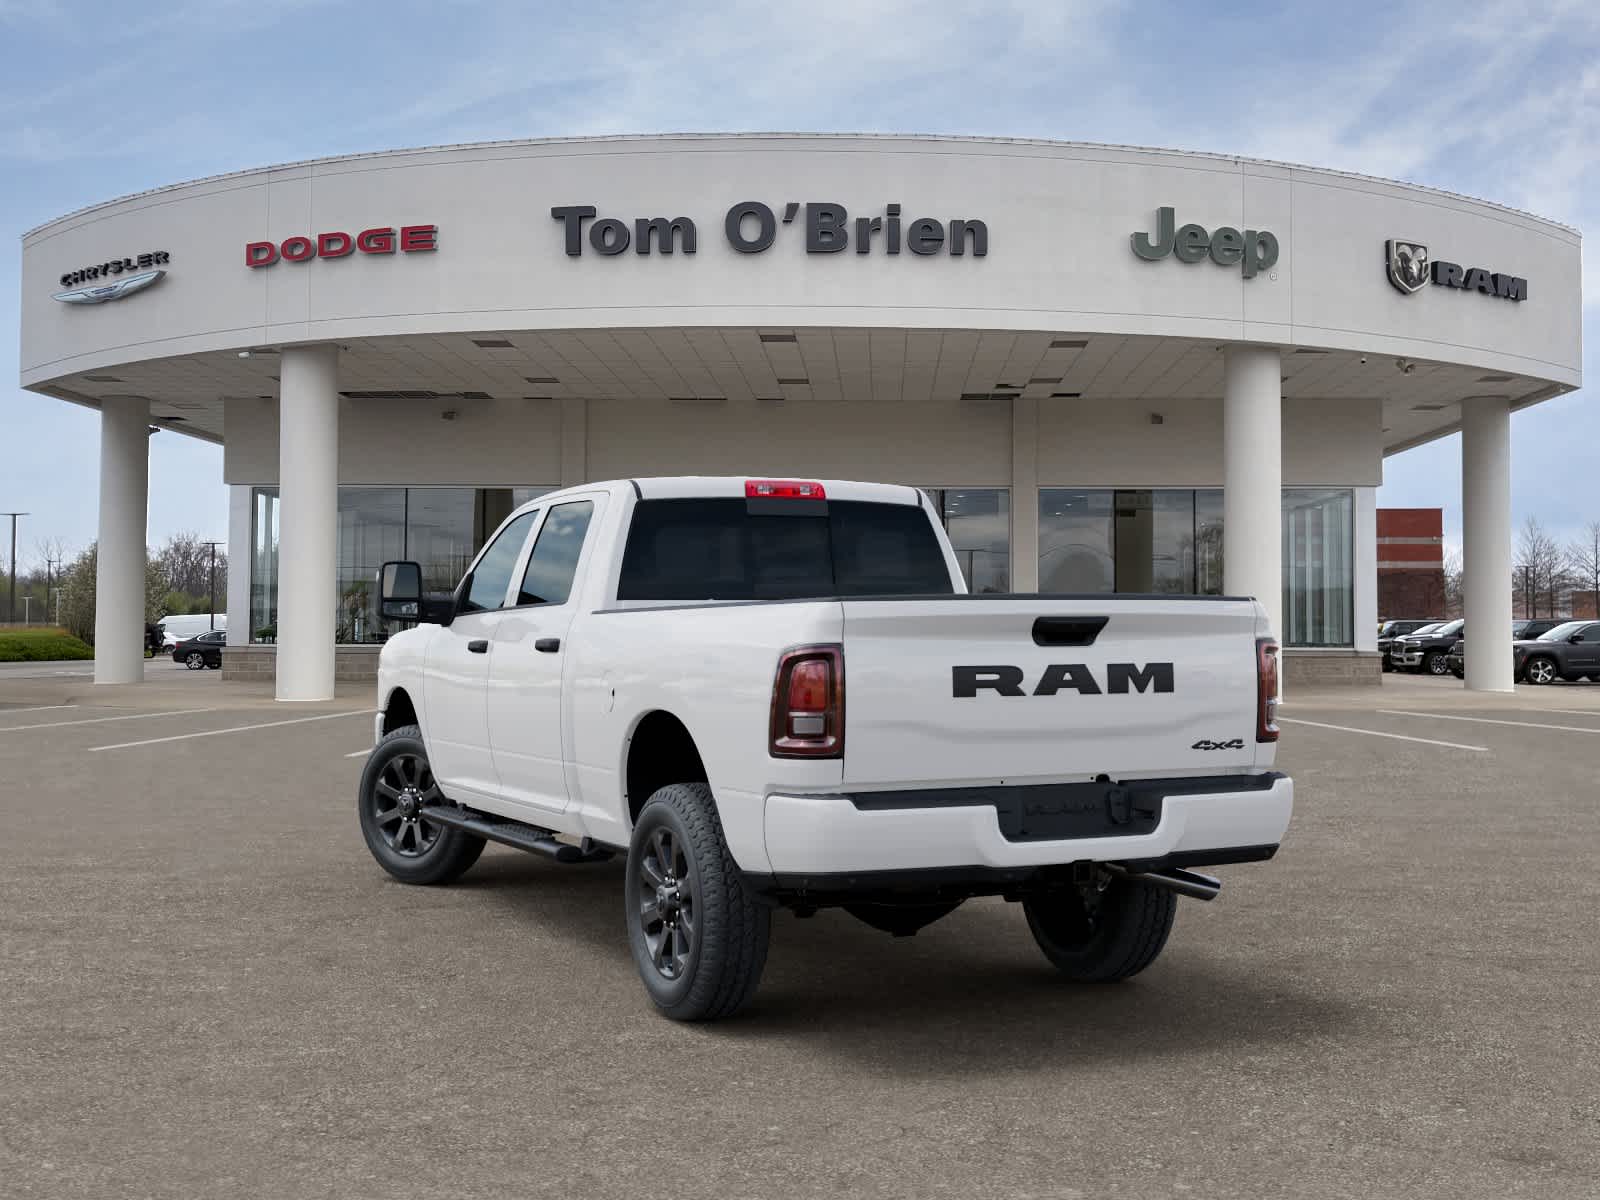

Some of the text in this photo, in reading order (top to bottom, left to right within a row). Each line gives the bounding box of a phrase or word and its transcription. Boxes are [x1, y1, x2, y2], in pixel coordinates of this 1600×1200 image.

[245, 224, 438, 268] DODGE
[551, 201, 988, 257] Tom O'Brien
[1131, 206, 1280, 279] Jeep
[60, 250, 170, 287] CHRYSLER
[1430, 260, 1528, 302] RAM
[952, 662, 1175, 698] RAM
[1191, 738, 1245, 751] 4x4
